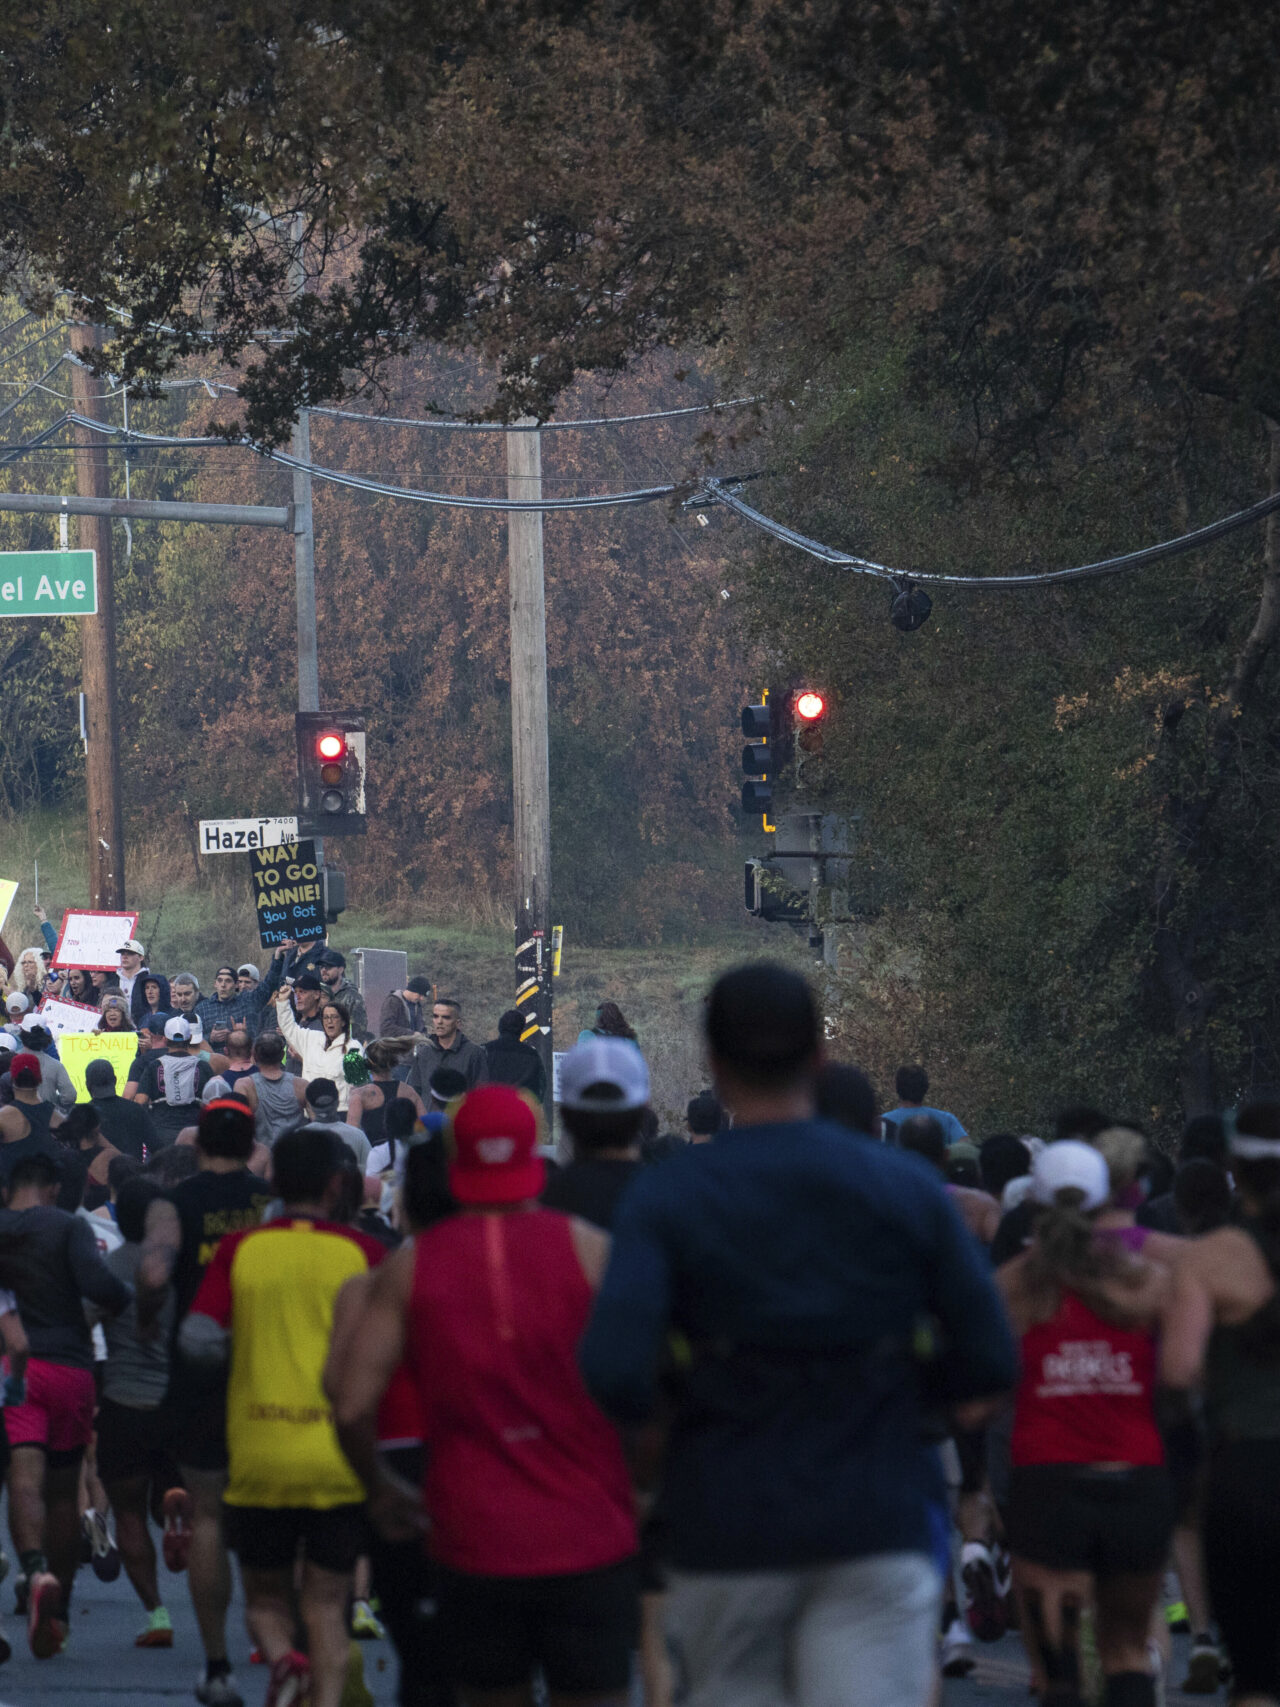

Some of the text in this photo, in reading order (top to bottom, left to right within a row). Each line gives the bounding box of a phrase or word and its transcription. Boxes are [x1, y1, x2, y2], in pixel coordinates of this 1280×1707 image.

[34, 575, 86, 601] Ave
[205, 825, 295, 850] Hazel Ave
[256, 843, 299, 866] WAY
[254, 863, 318, 888] TO GO
[257, 883, 321, 910] ANNIE!
[292, 904, 317, 918] Got
[294, 924, 323, 939] Love
